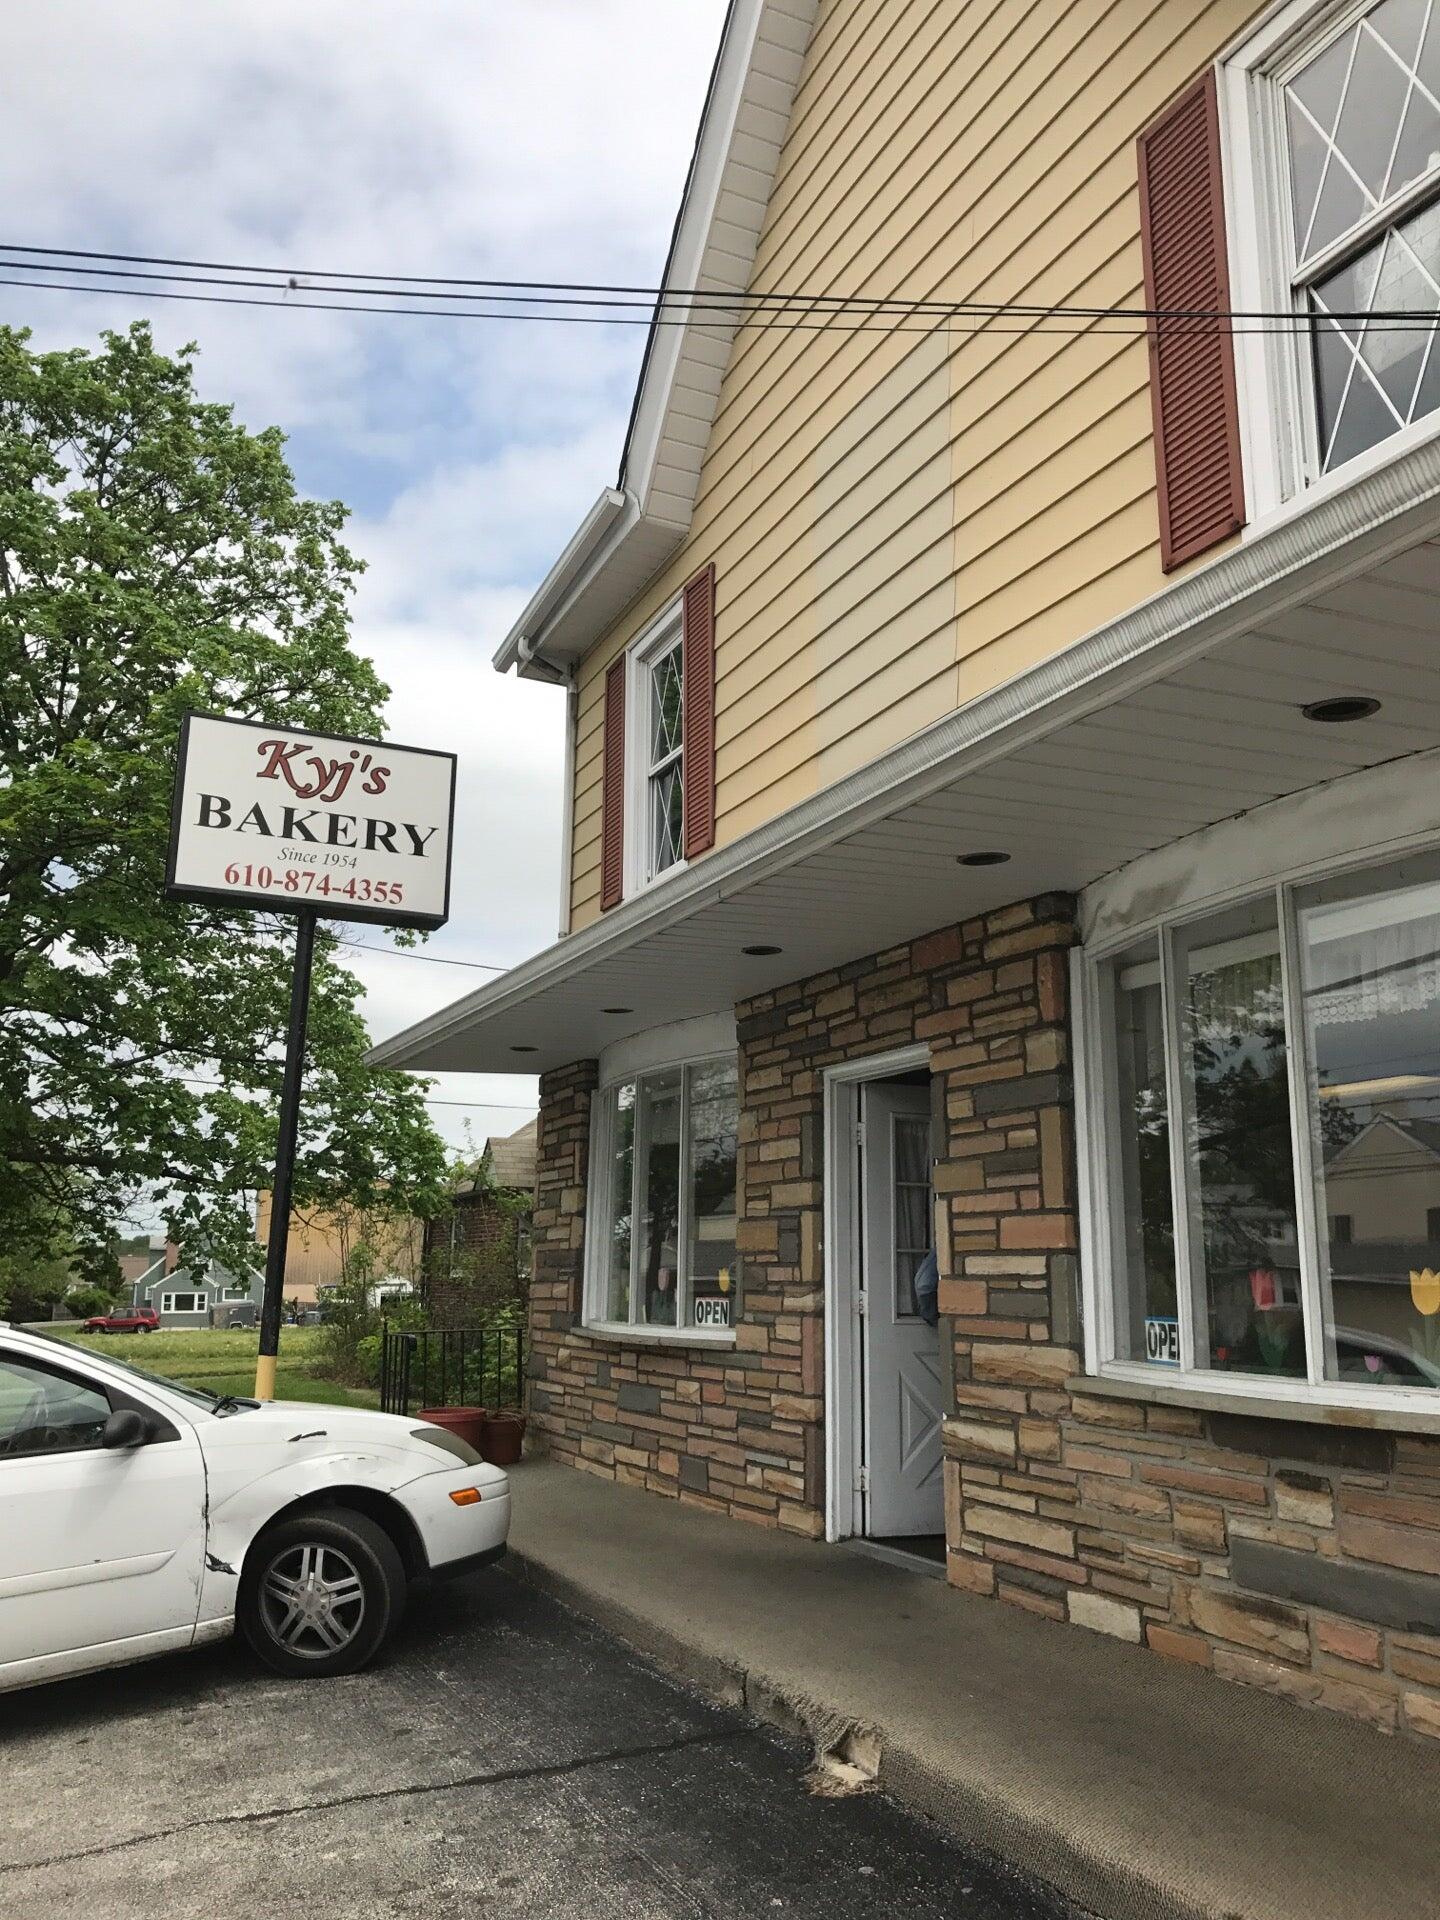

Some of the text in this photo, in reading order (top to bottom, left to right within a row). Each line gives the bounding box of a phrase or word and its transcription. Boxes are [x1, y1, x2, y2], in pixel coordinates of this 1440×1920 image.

[256, 739, 391, 803] Kyj's
[193, 793, 439, 858] BAKERY
[277, 847, 358, 869] Since 1954
[224, 862, 403, 905] 610-874-4355
[696, 1301, 728, 1324] OPEN
